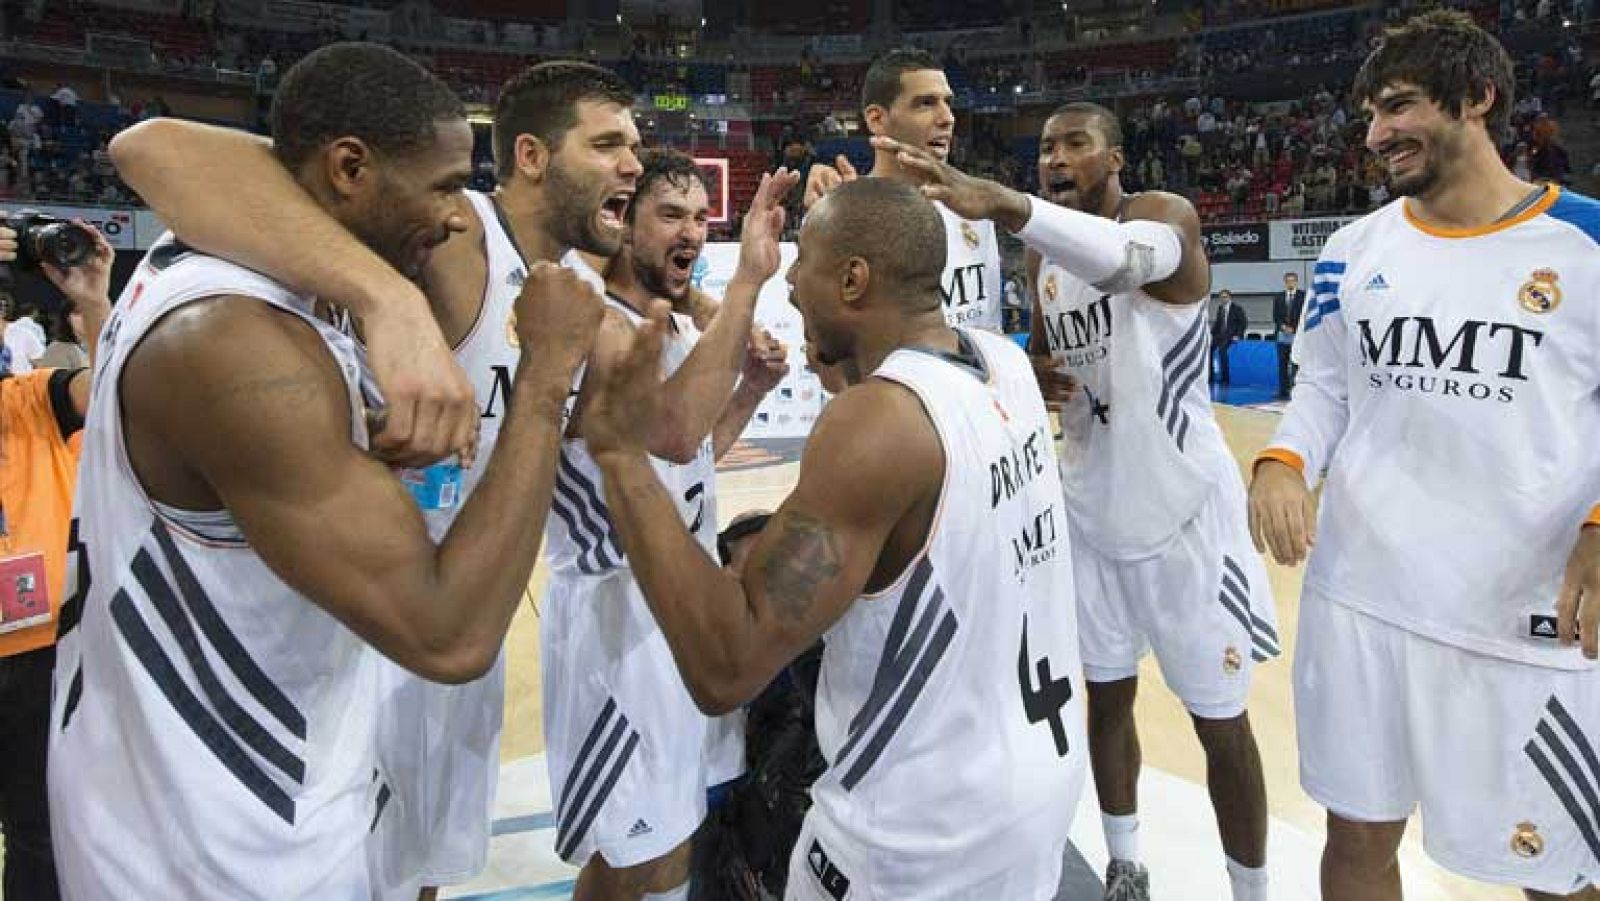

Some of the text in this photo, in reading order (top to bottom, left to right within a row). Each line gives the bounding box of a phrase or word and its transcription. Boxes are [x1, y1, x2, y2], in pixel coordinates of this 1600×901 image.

[939, 263, 987, 307] MT
[1357, 316, 1545, 381] MMT
[1018, 611, 1072, 757] 4
